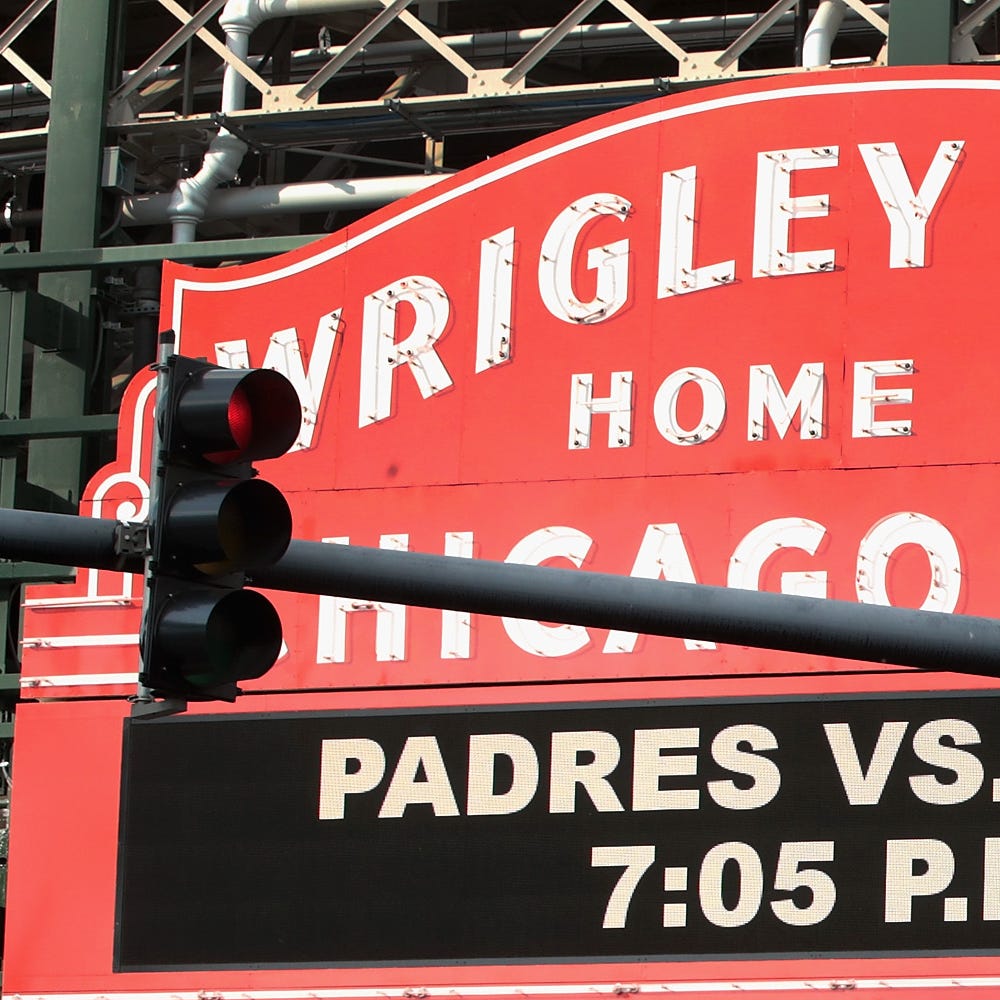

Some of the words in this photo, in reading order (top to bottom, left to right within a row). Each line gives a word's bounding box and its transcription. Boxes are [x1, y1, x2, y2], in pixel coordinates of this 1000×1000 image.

[214, 141, 965, 455] WRIGLEY
[568, 359, 915, 451] HOME
[280, 511, 962, 664] HICAGO
[318, 723, 781, 820] PADRES
[590, 840, 837, 929] 7:05
